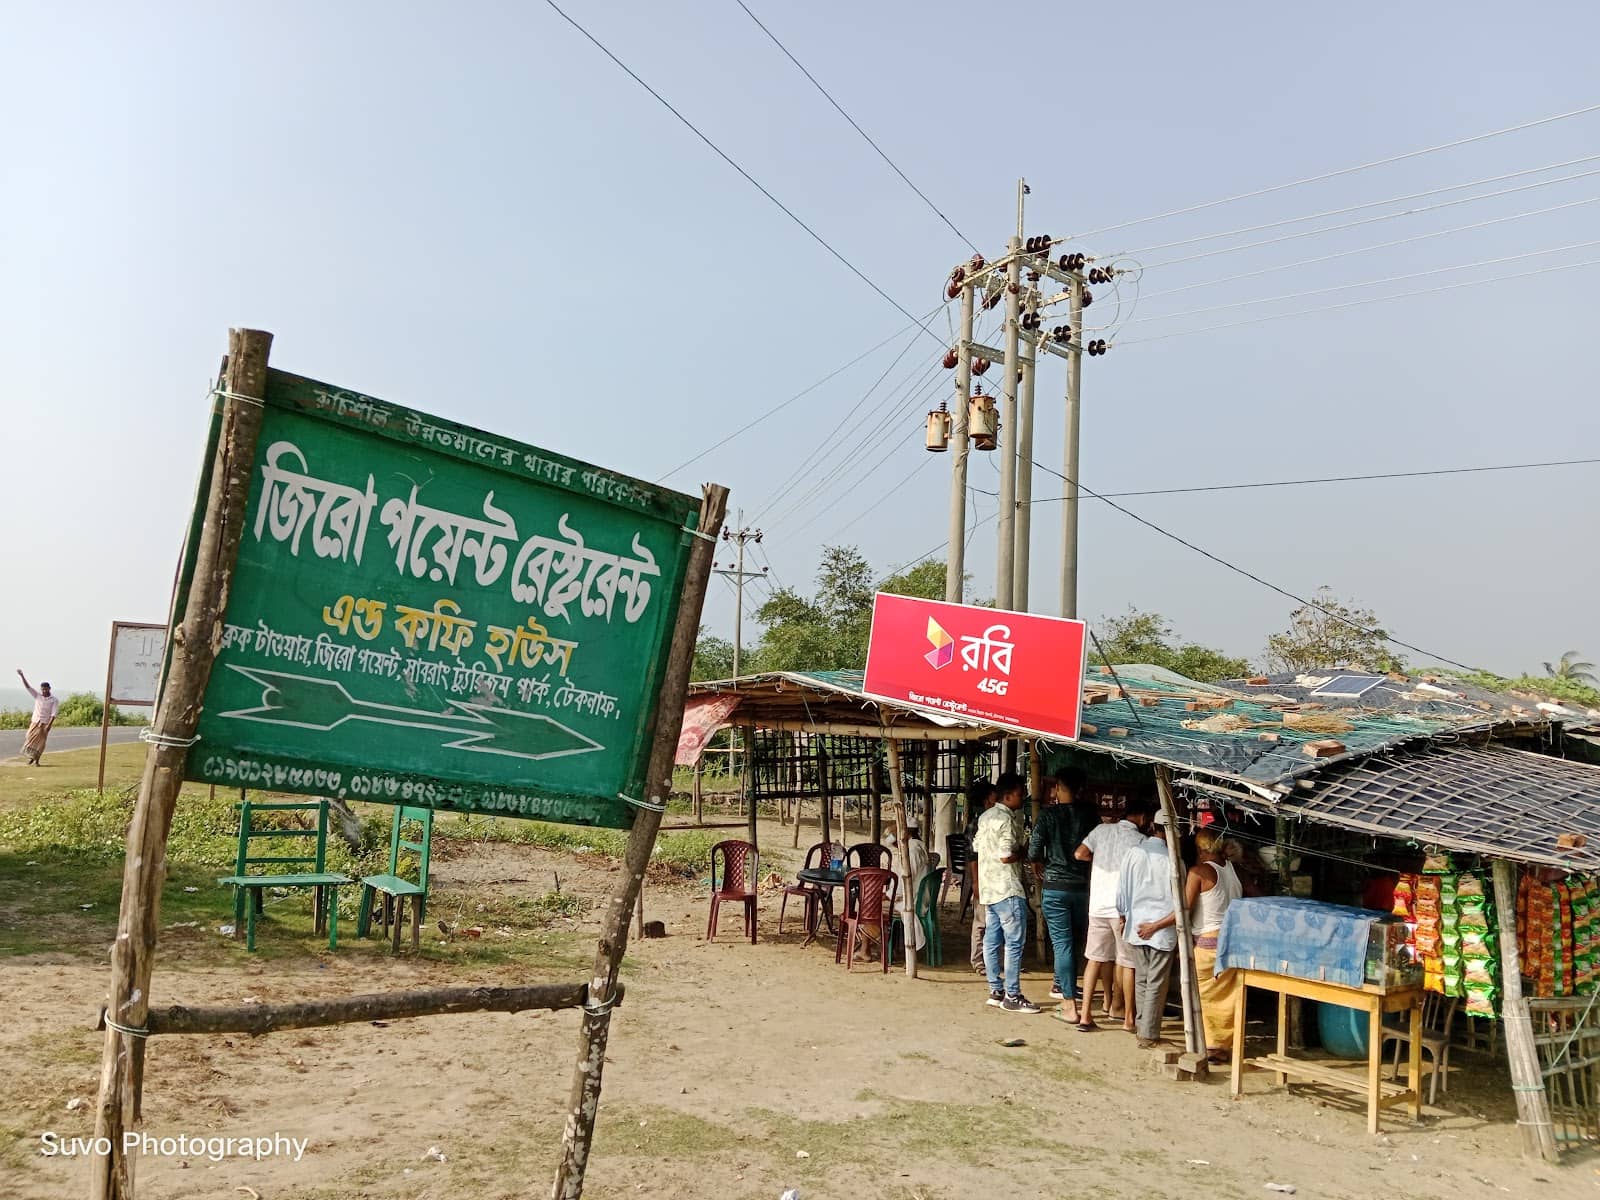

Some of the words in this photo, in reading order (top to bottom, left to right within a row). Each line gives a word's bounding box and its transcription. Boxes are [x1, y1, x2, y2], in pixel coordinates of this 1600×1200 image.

[405, 410, 519, 467] উন্নতমানের
[524, 453, 577, 486] খাবার
[253, 440, 378, 567] জিরো
[380, 490, 519, 587] পয়েন্ট
[511, 512, 661, 625] রেস্টুরেন্ট
[255, 618, 313, 669] টাওয়ার,
[313, 632, 356, 673] জিরো
[357, 645, 402, 682] পয়েন্ট,
[402, 657, 452, 691] সাবরাং
[516, 673, 551, 709] পার্ক,
[394, 598, 478, 656] কফি
[484, 616, 579, 677] হাউস
[960, 624, 1015, 677] রবি
